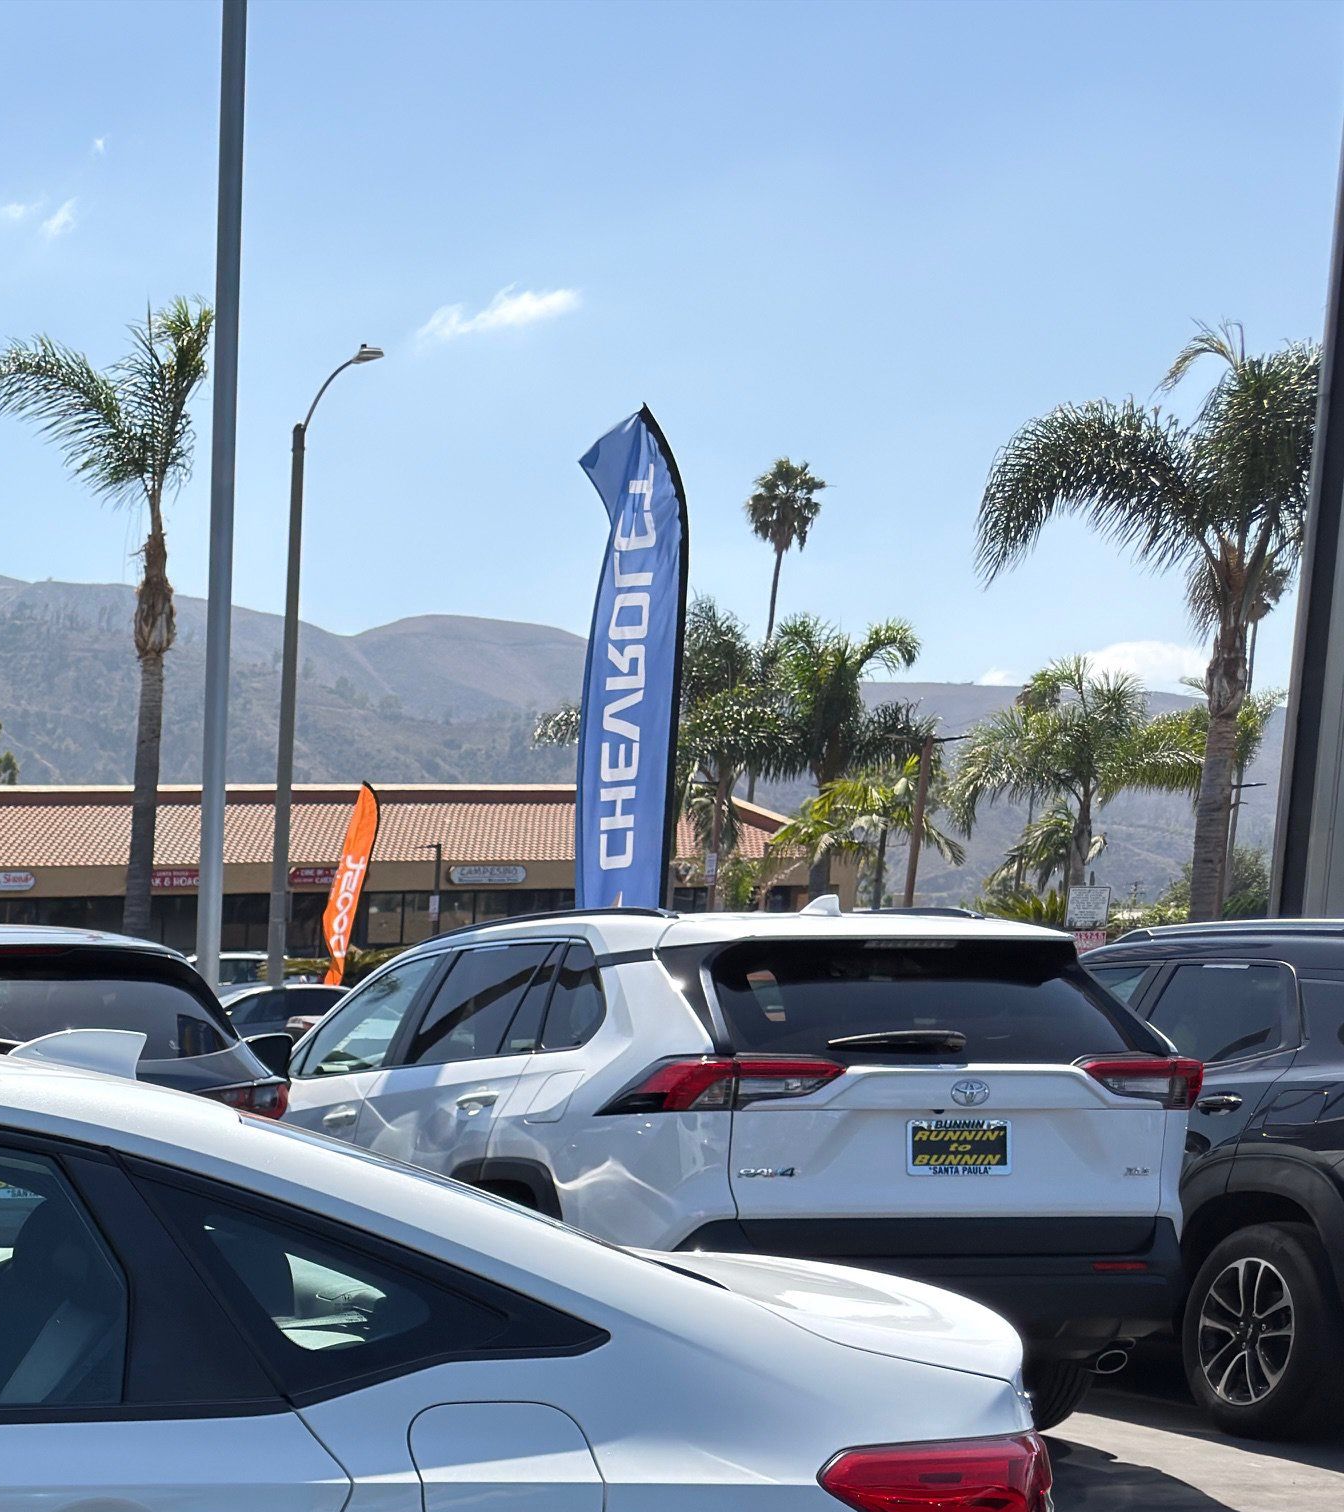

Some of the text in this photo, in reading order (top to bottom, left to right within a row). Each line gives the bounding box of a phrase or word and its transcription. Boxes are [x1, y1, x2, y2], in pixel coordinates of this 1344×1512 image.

[935, 1120, 985, 1129] BUNNIN
[914, 1130, 1005, 1141] RUNNIN'
[949, 1142, 971, 1151] to
[913, 1154, 1001, 1165] BUNNIN
